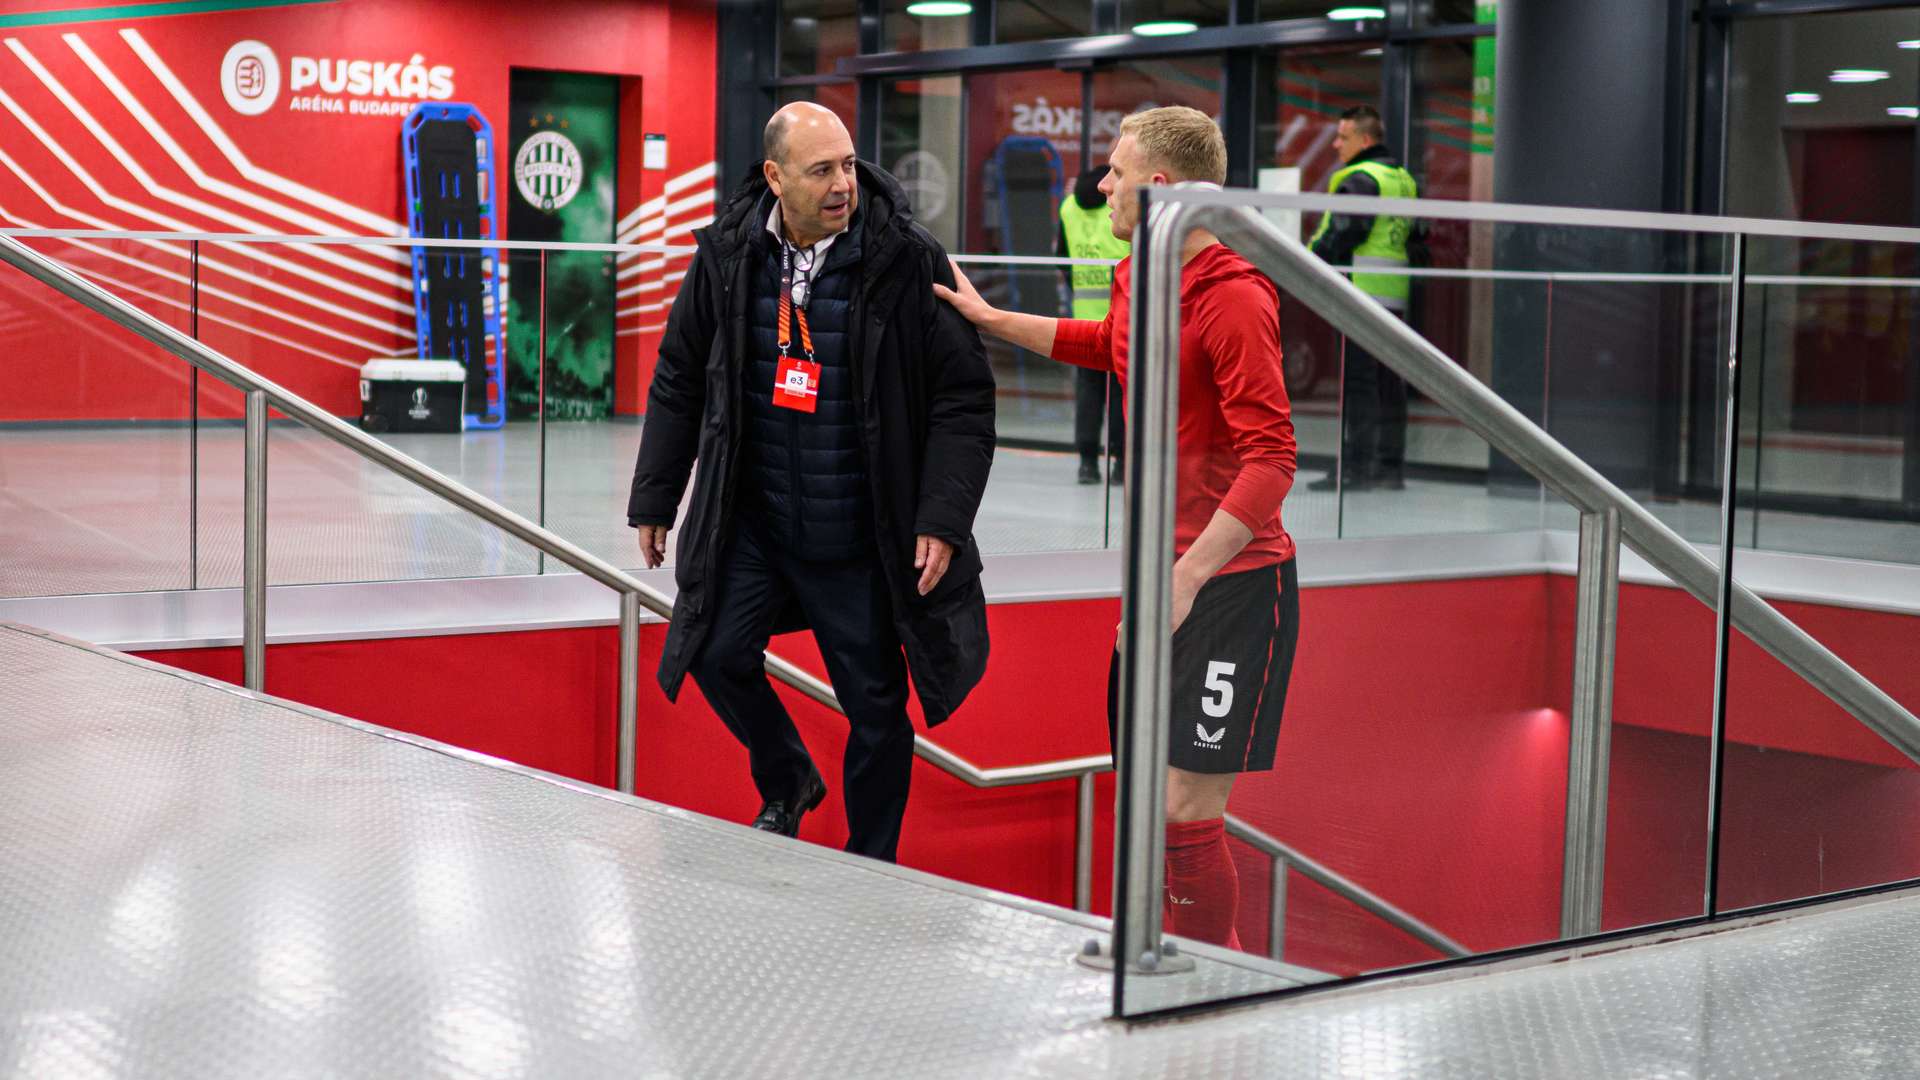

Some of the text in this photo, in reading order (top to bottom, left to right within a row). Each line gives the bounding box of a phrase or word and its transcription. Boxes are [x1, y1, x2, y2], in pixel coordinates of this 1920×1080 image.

[291, 54, 455, 100] PUSKÁS
[289, 95, 416, 117] ARÉNA BUDAPES
[790, 376, 803, 386] e3
[1201, 660, 1237, 718] 5
